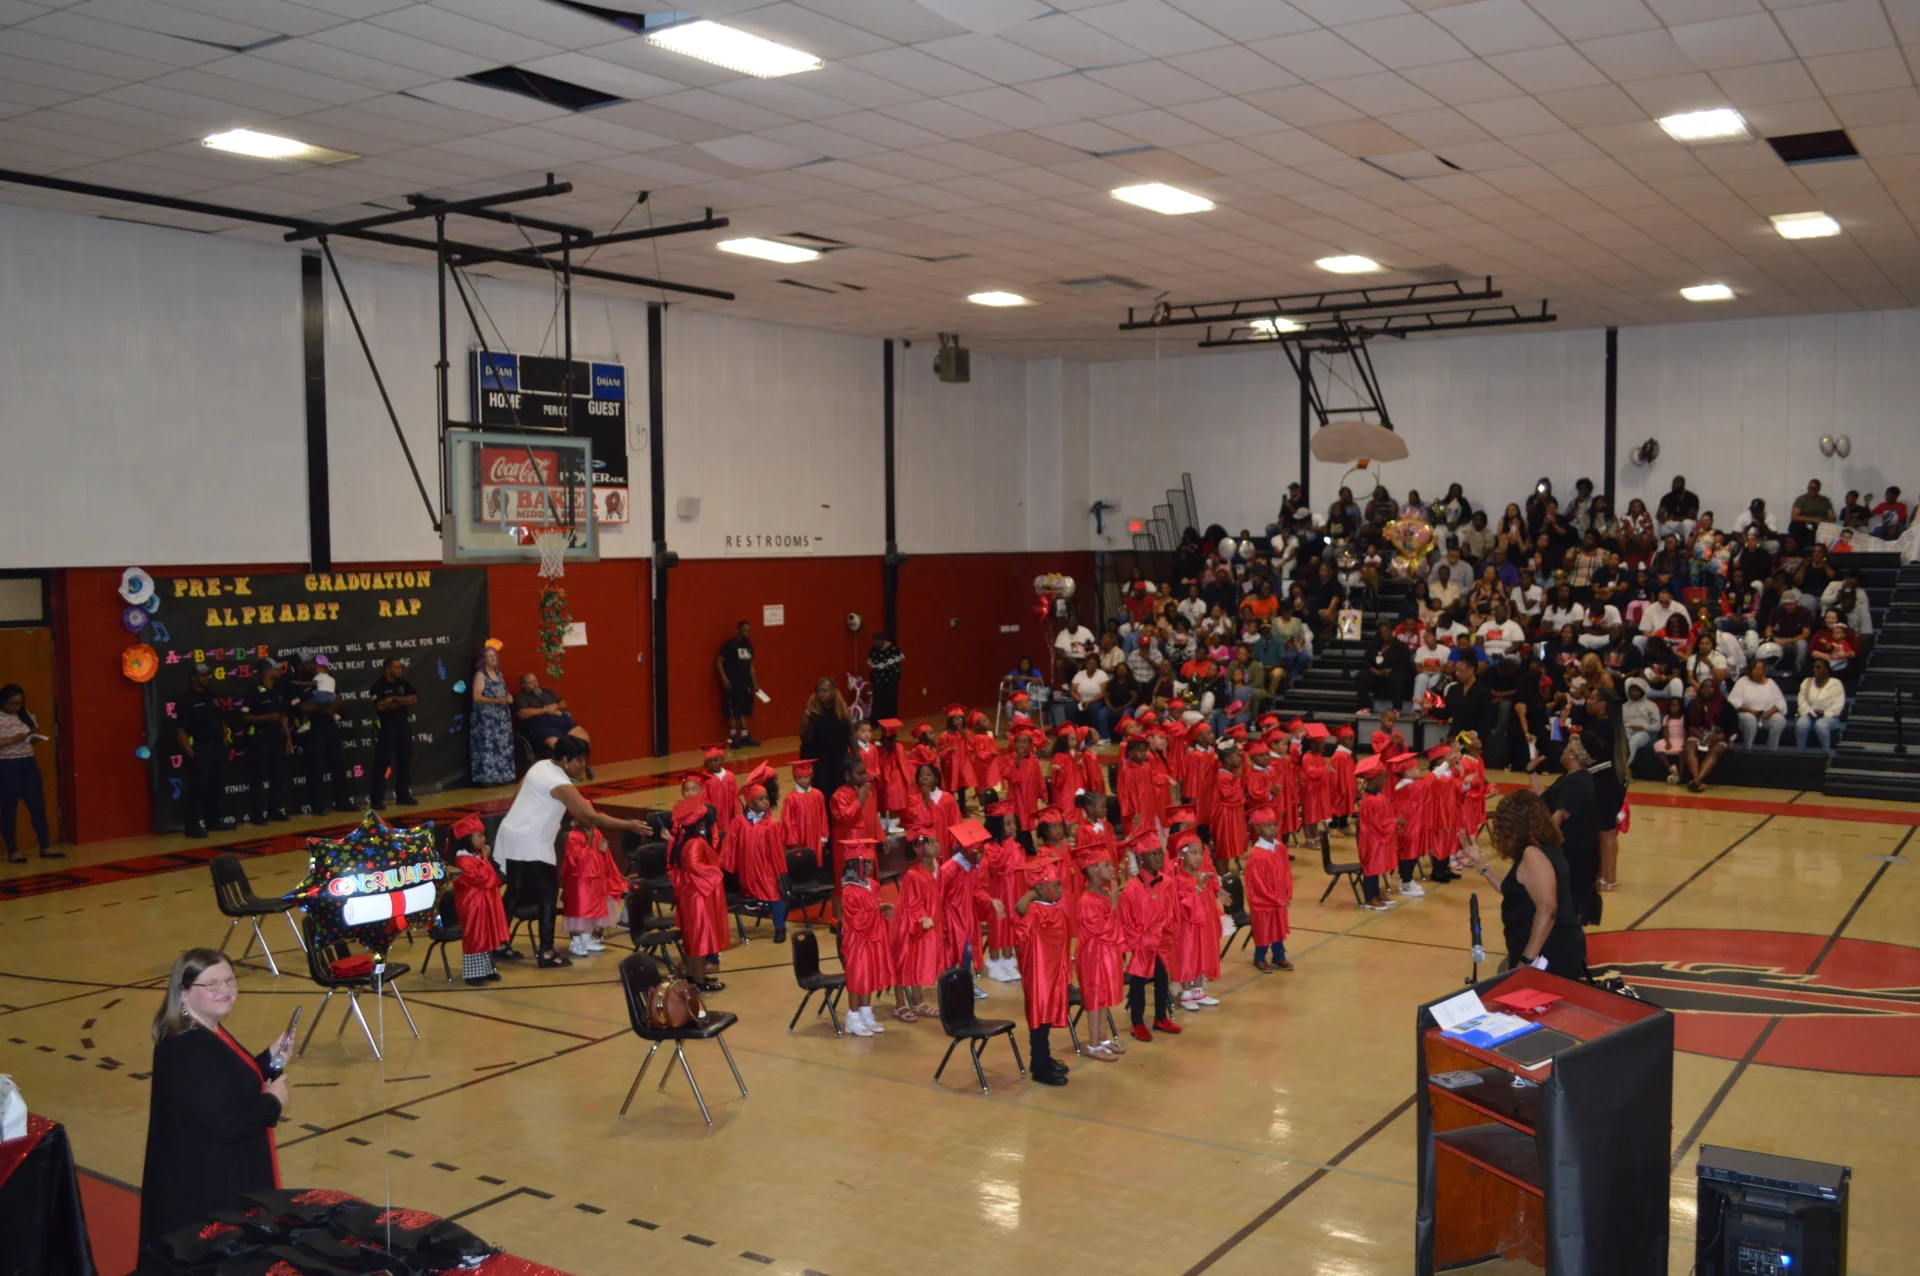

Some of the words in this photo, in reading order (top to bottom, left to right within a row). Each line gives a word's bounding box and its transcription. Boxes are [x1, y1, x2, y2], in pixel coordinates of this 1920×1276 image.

[588, 400, 621, 416] GUEST
[725, 535, 809, 547] RESTROOMS
[173, 576, 252, 597] PRE-K
[304, 570, 431, 592] GRADUATION
[205, 602, 340, 627] ALPHABET
[378, 598, 422, 618] RAP
[345, 643, 362, 652] WILL
[366, 642, 375, 651] BE
[378, 640, 392, 649] THE
[395, 639, 417, 648] PLACE
[419, 637, 433, 646] FOR
[345, 660, 366, 669] BEST
[328, 861, 445, 896] CONGRATULATIONS
